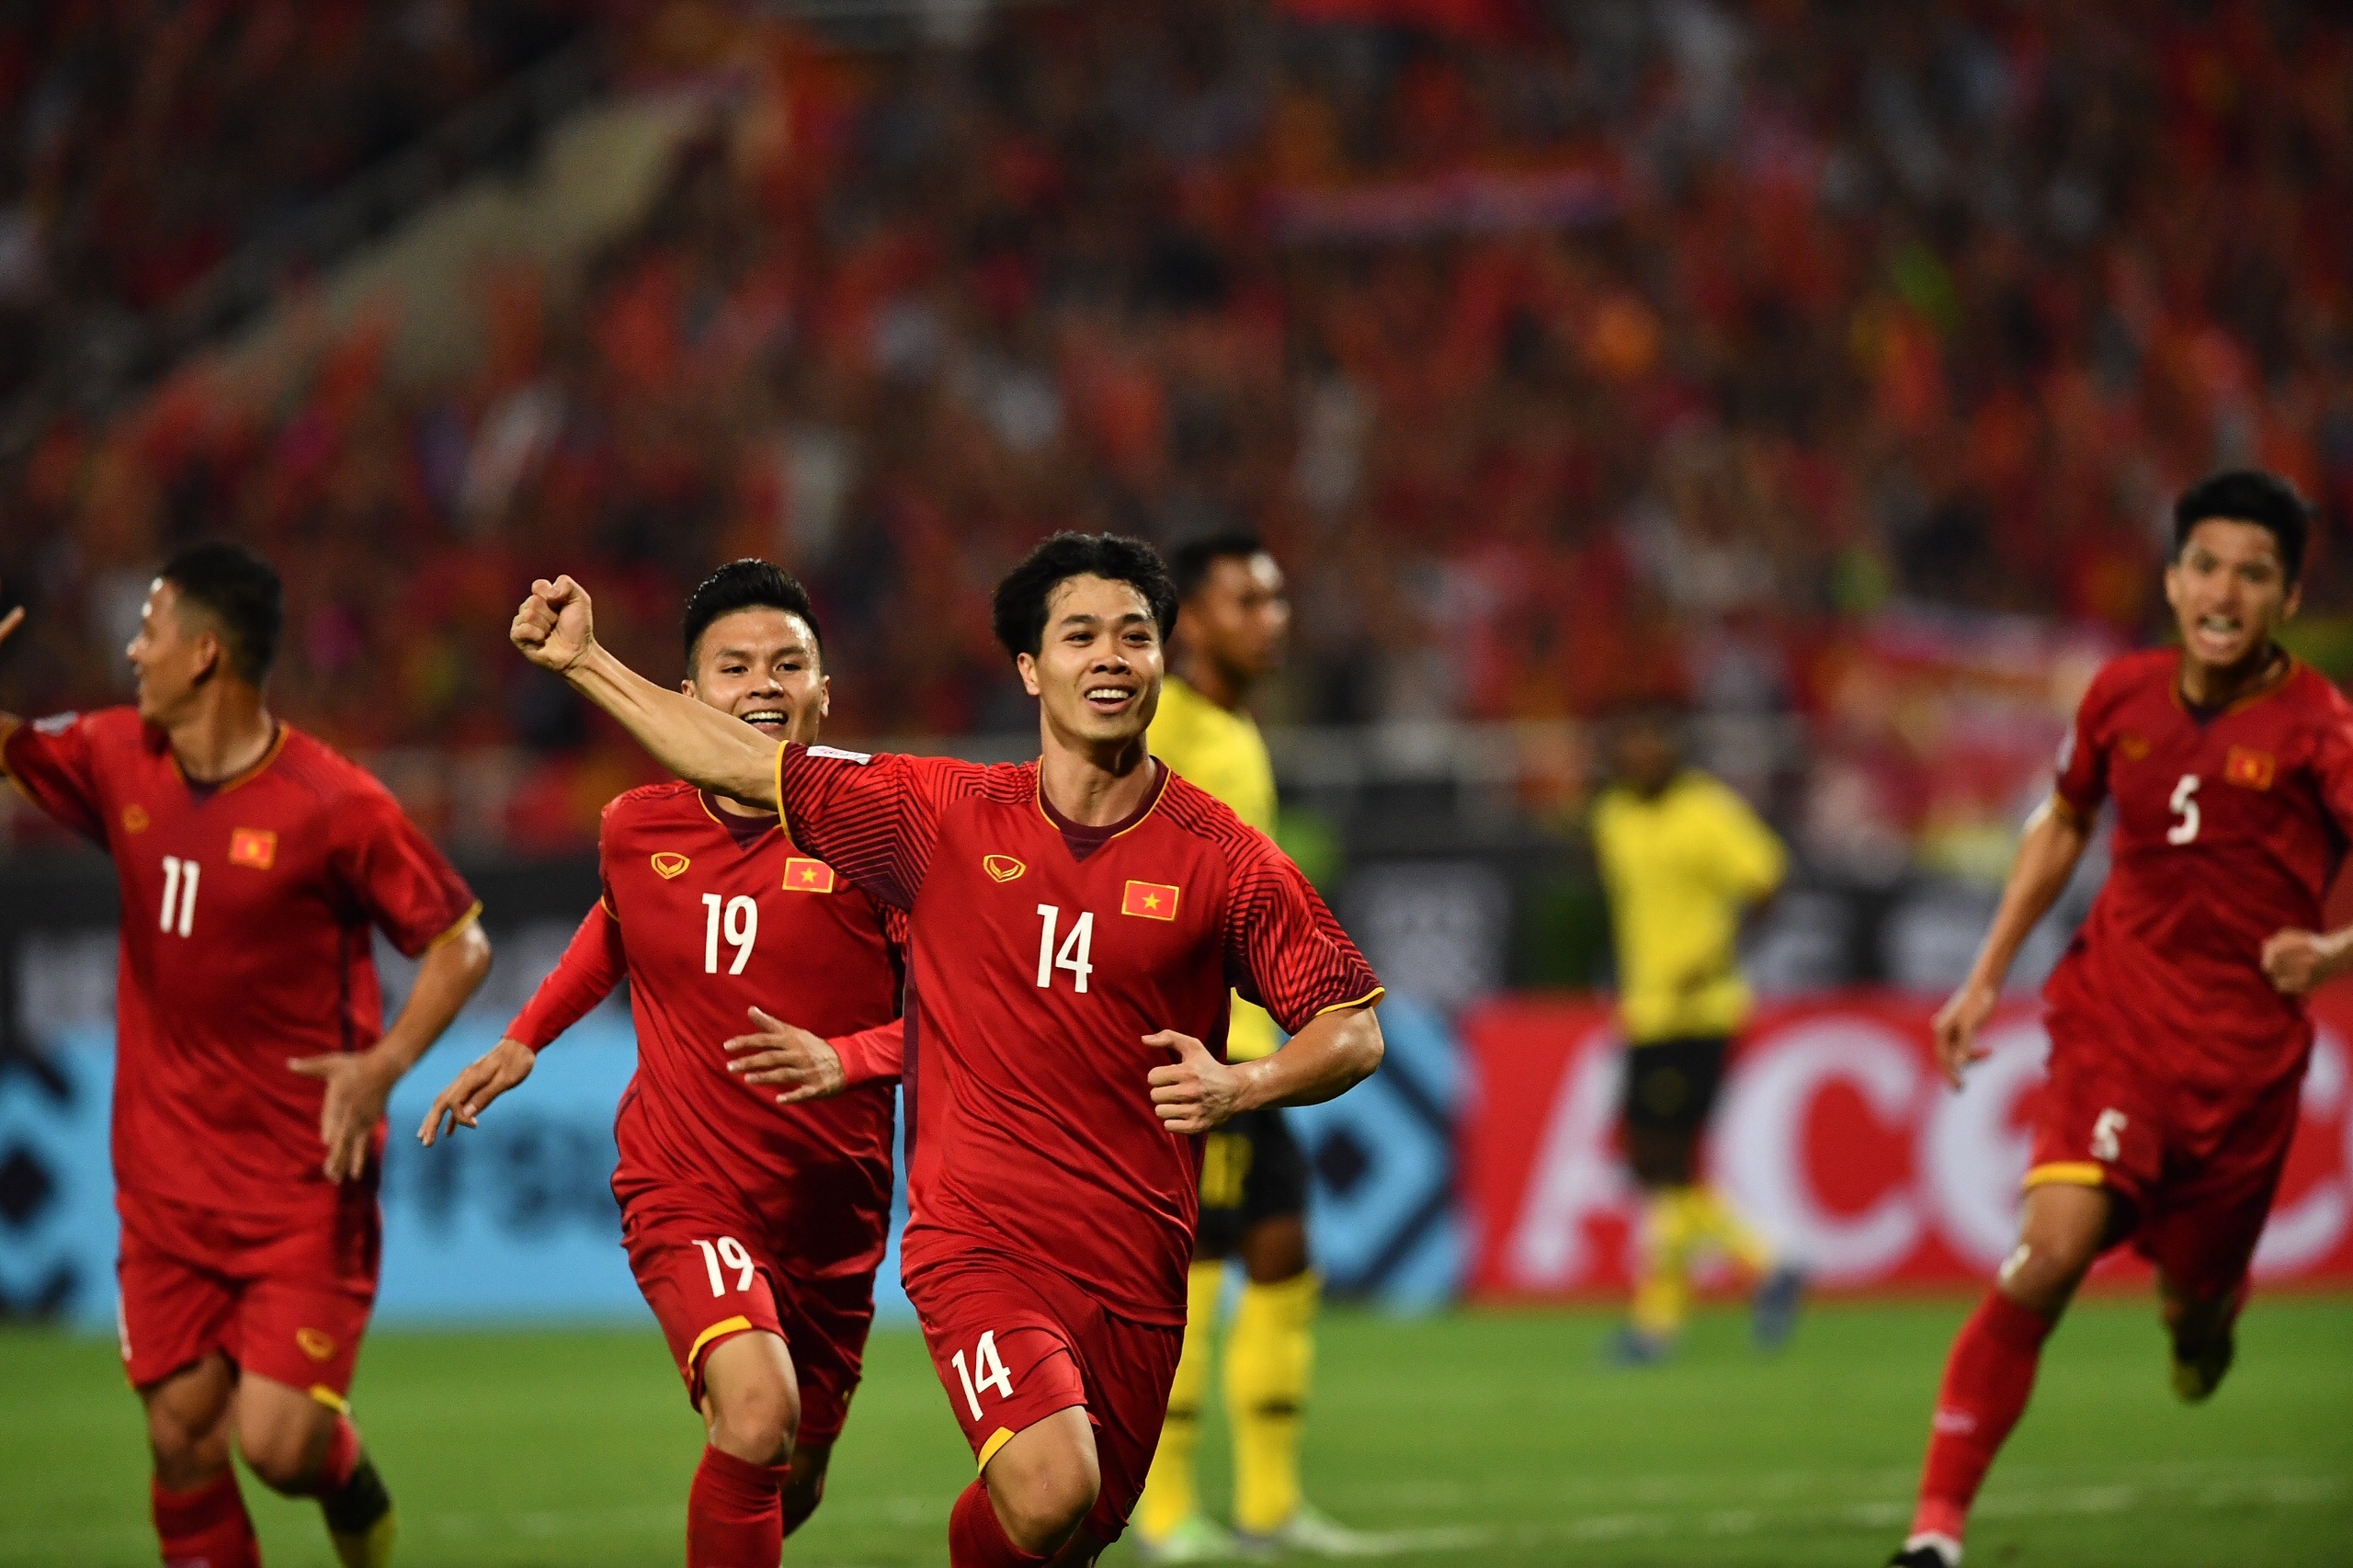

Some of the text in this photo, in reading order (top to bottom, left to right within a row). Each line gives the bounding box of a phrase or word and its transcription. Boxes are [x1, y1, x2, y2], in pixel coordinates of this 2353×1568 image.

[2167, 773, 2200, 845] 5
[159, 854, 200, 937] 11
[701, 893, 759, 975] 19
[1036, 903, 1095, 994] 14
[2091, 1108, 2128, 1160] 5
[691, 1235, 756, 1299] 19
[950, 1329, 1014, 1422] 14
